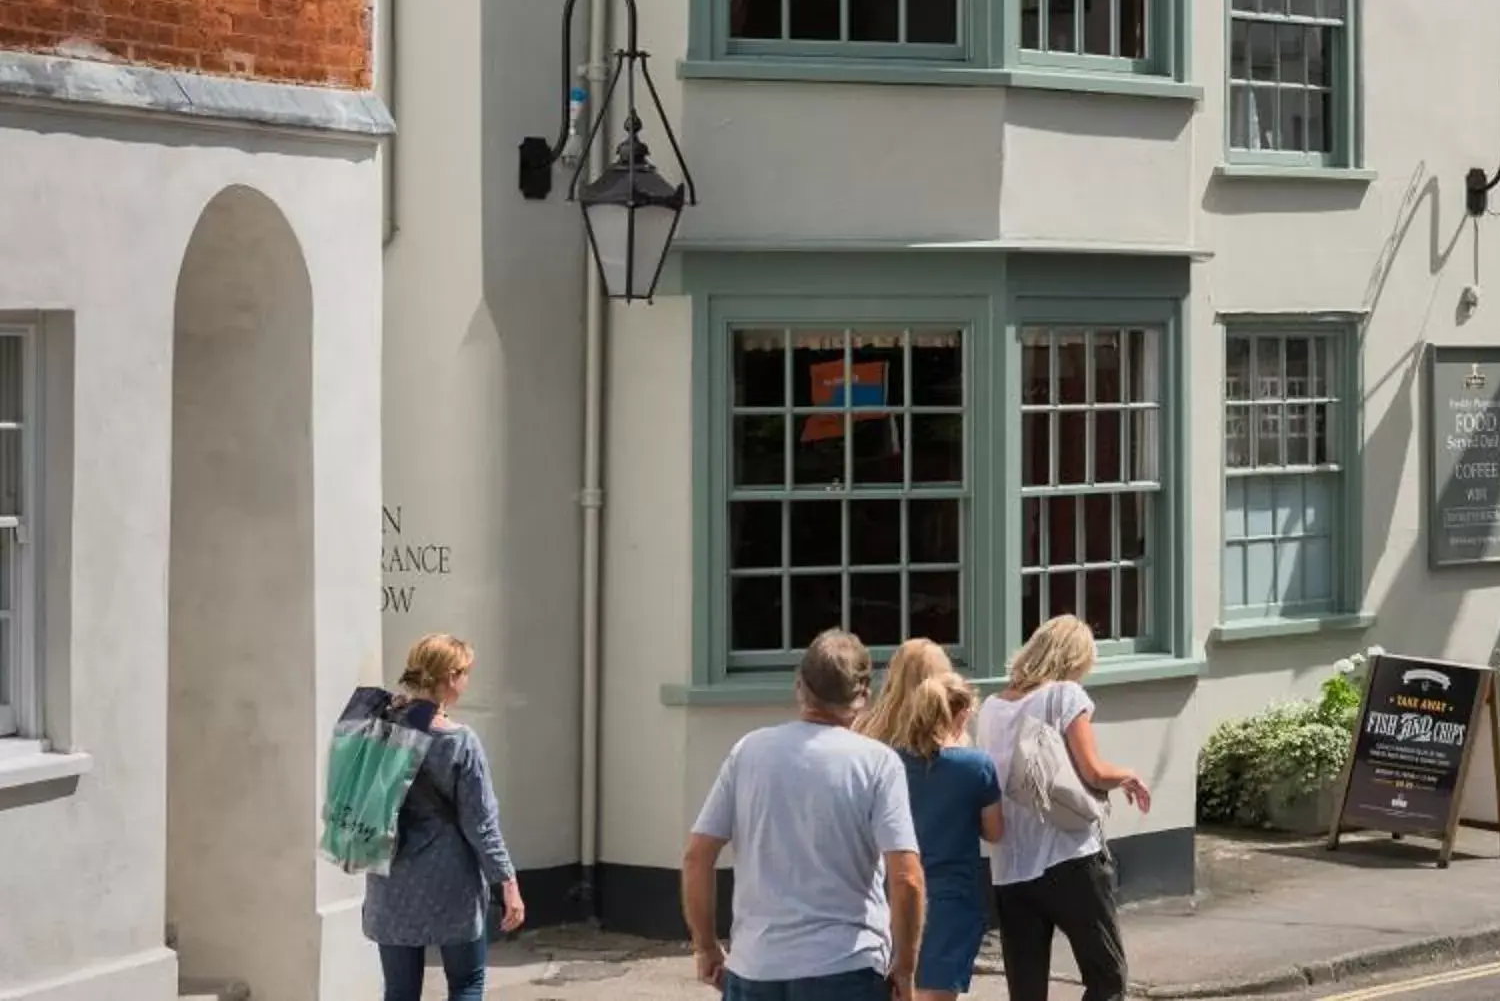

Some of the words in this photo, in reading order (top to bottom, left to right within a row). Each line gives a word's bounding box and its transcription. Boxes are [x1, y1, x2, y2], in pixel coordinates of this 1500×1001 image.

[1455, 411, 1497, 433] FOOD
[1455, 462, 1499, 479] COFFEE
[381, 544, 451, 574] ANCE
[1366, 710, 1398, 736] FISH
[1433, 721, 1466, 746] CHIPS
